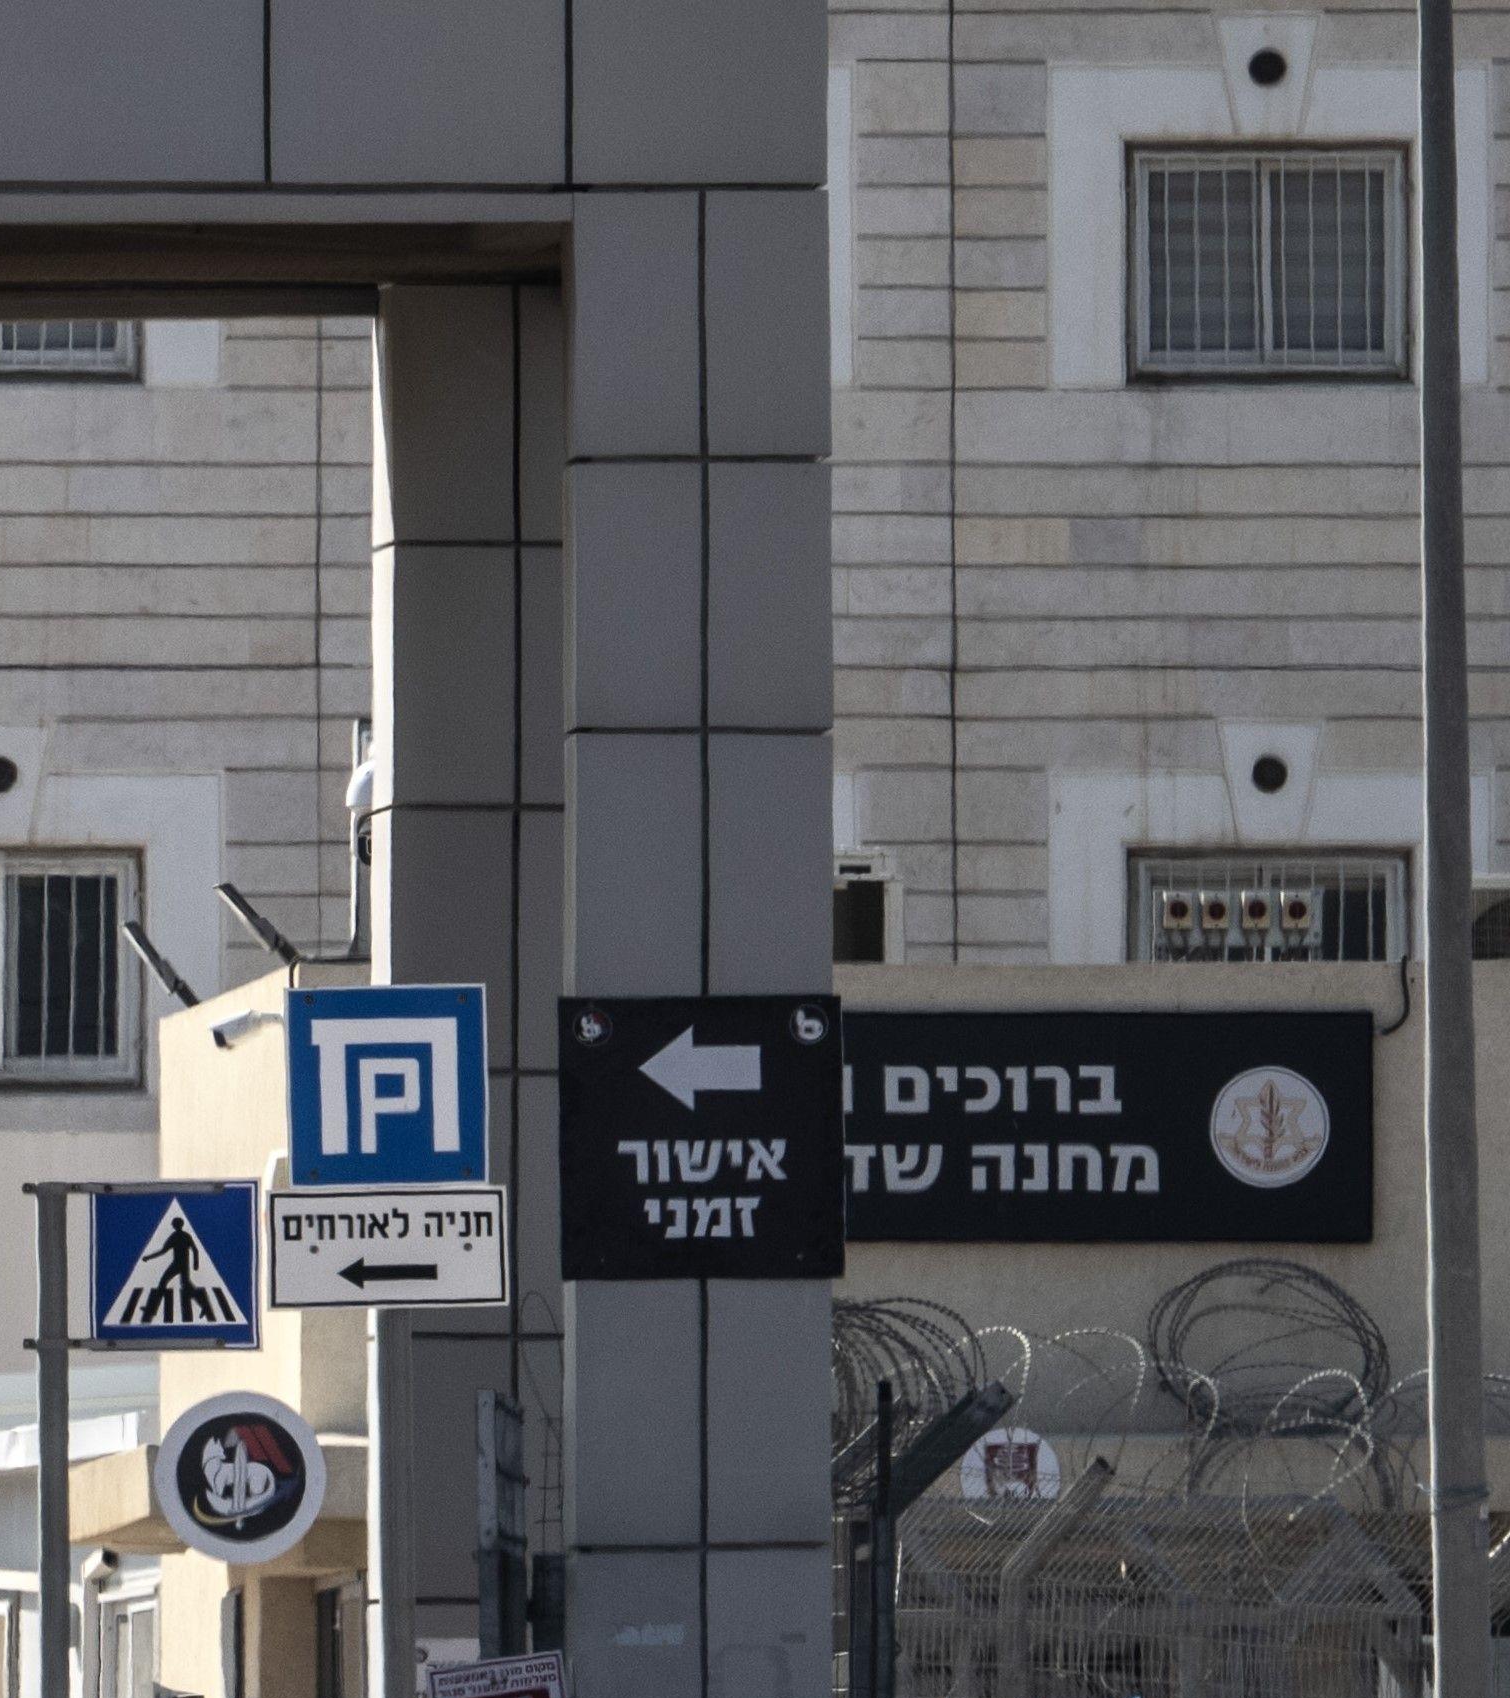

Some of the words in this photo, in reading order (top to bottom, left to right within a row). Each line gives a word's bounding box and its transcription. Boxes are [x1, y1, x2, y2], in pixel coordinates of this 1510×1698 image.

[884, 1066, 1121, 1113] ברוכים
[618, 1139, 786, 1183] אישור
[845, 1145, 942, 1191] שד
[972, 1144, 1159, 1192] מחנה
[282, 1208, 409, 1241] לאורחים
[425, 1211, 492, 1237] חניה
[644, 1197, 760, 1238] זמני
